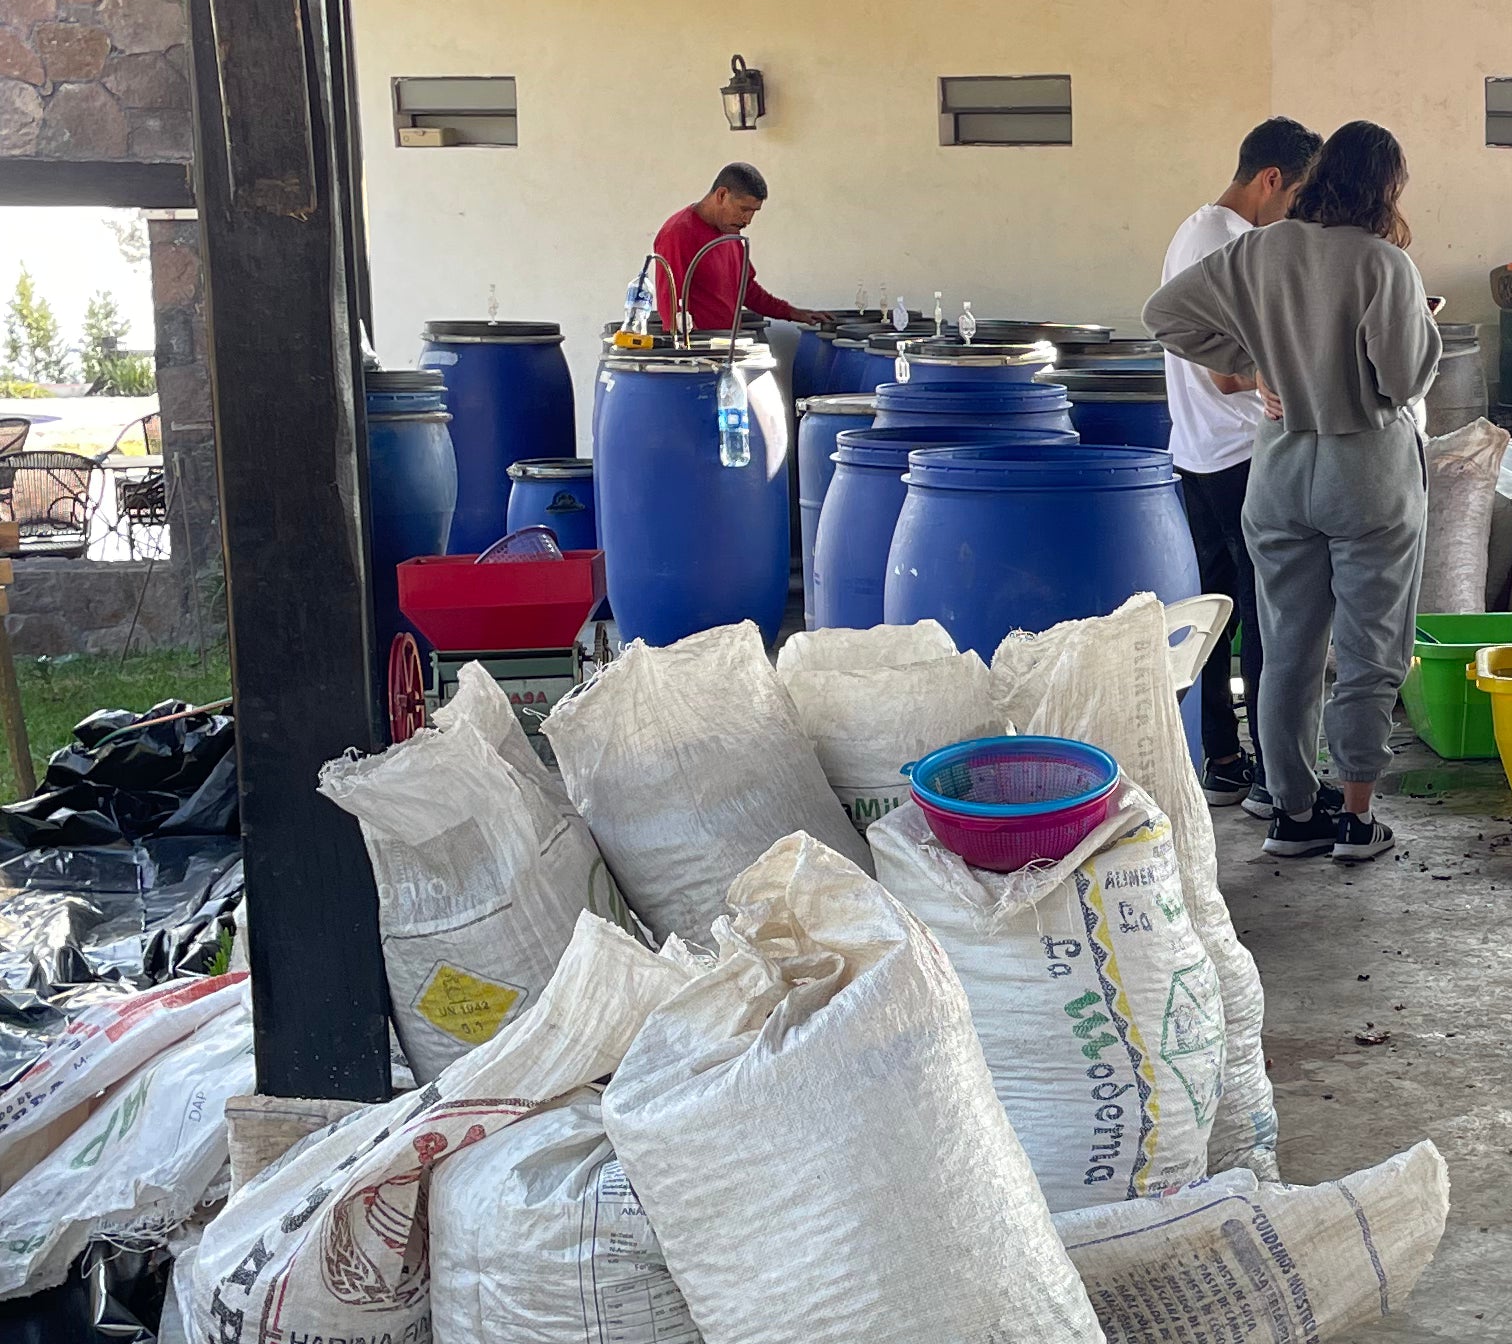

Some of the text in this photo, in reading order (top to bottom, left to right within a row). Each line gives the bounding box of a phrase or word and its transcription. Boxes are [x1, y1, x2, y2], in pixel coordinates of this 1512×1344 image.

[1040, 935, 1136, 1186] La Moderna
[187, 1090, 206, 1123] DAP
[1218, 1296, 1230, 1310] DE
[1235, 1290, 1246, 1303] DE
